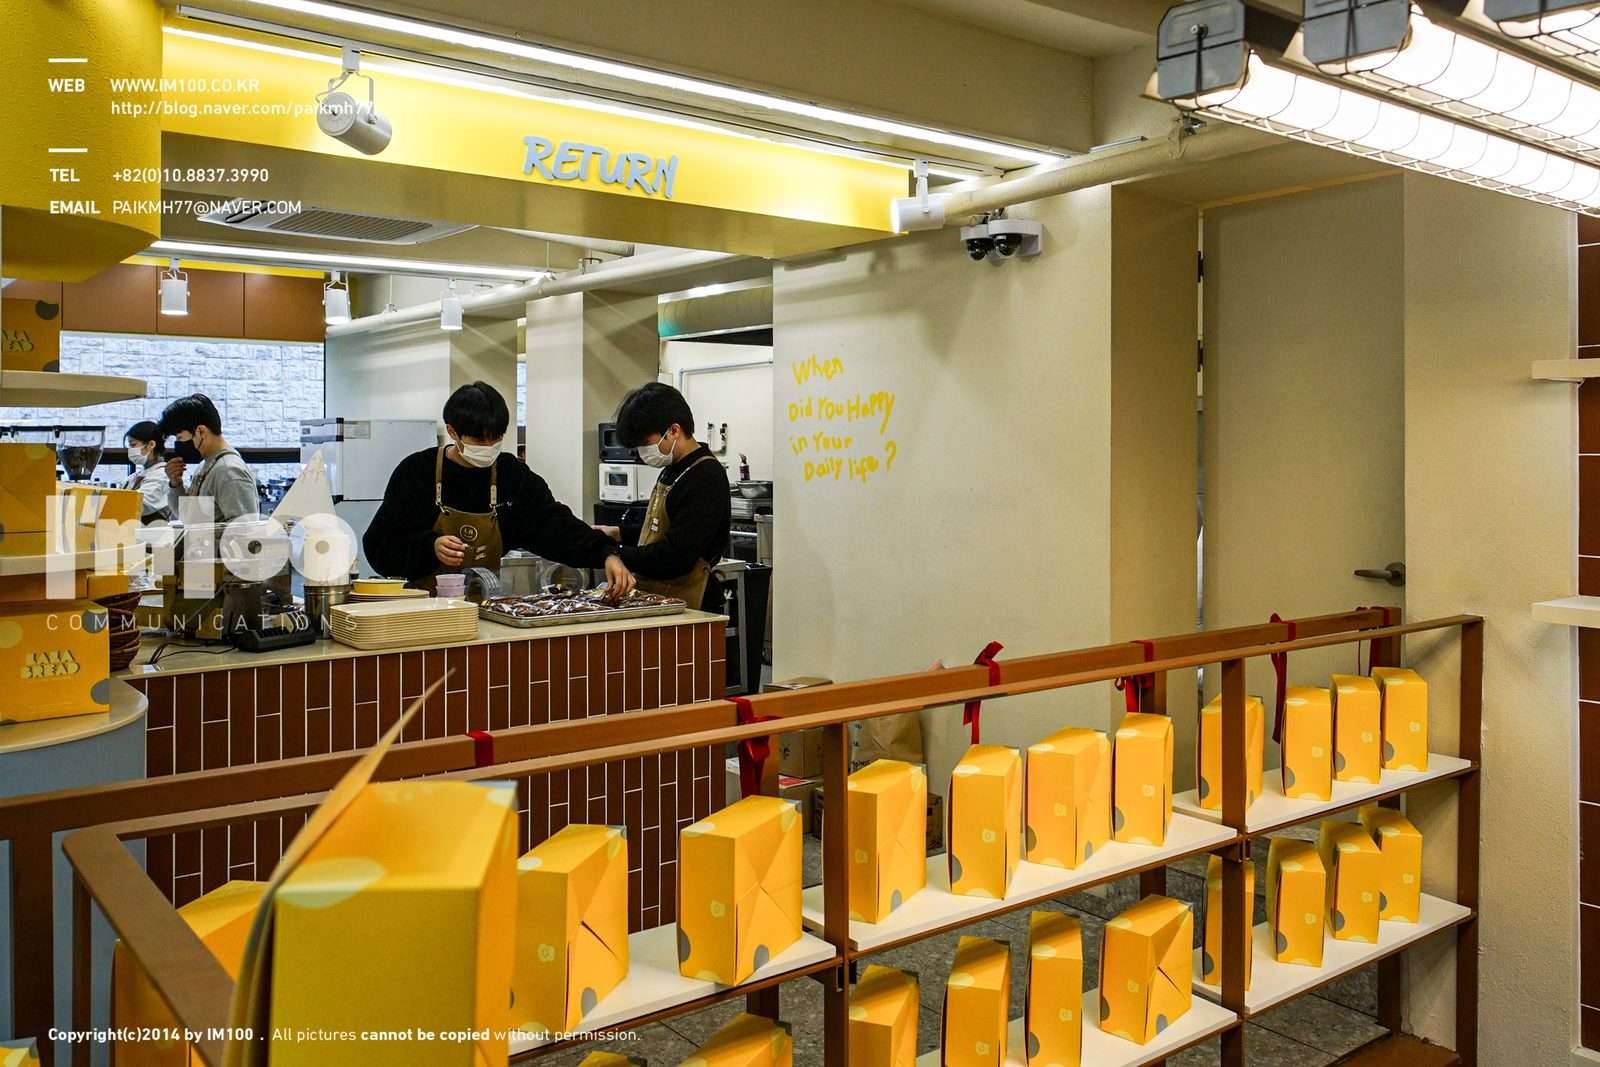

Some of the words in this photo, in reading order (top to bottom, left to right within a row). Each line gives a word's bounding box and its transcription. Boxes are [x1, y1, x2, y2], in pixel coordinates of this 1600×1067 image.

[523, 135, 679, 199] RETURN
[792, 354, 844, 385] When
[789, 397, 813, 422] Did
[847, 391, 896, 434] Happy
[789, 435, 809, 456] in
[804, 457, 843, 482] Daily
[20, 661, 81, 679] BREAD
